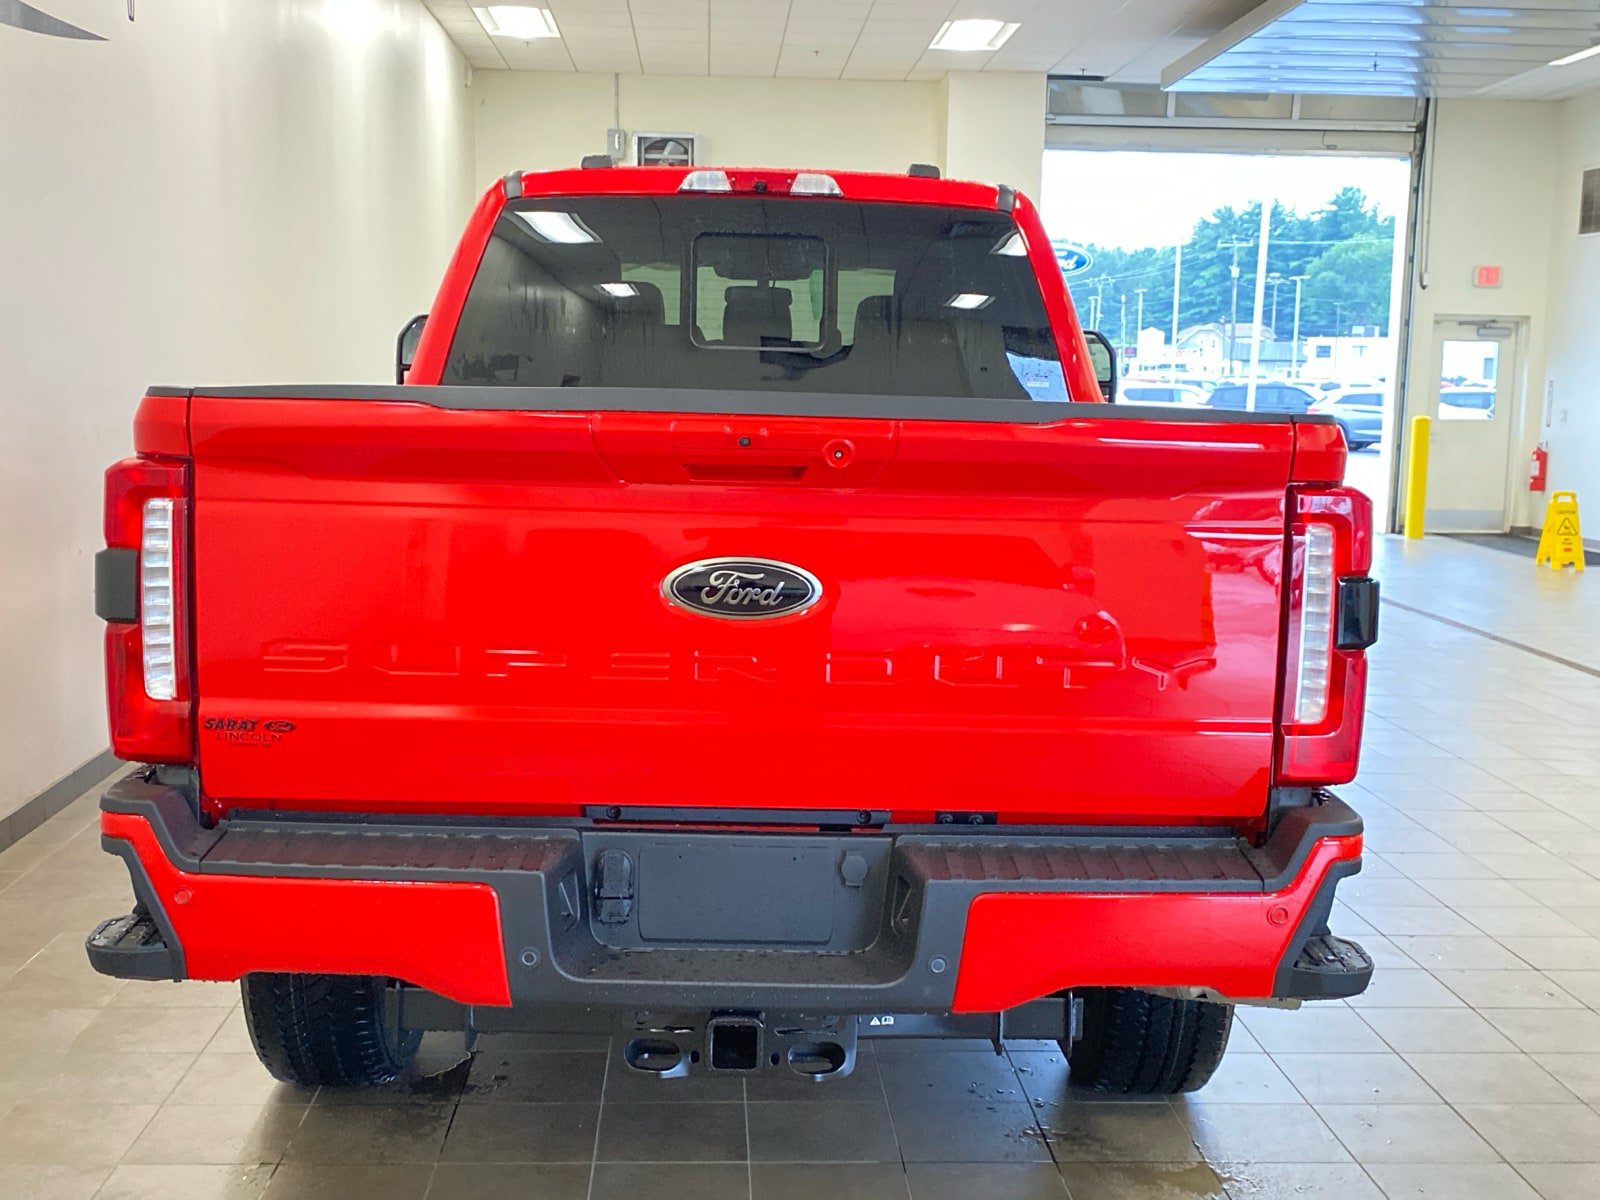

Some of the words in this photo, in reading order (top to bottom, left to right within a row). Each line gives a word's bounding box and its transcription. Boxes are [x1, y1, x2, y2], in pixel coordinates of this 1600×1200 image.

[700, 570, 785, 606] Ford
[261, 640, 777, 683] SUPER
[825, 652, 1217, 690] DUTY
[204, 718, 259, 732] SARAT
[216, 731, 282, 743] LINCOLN
